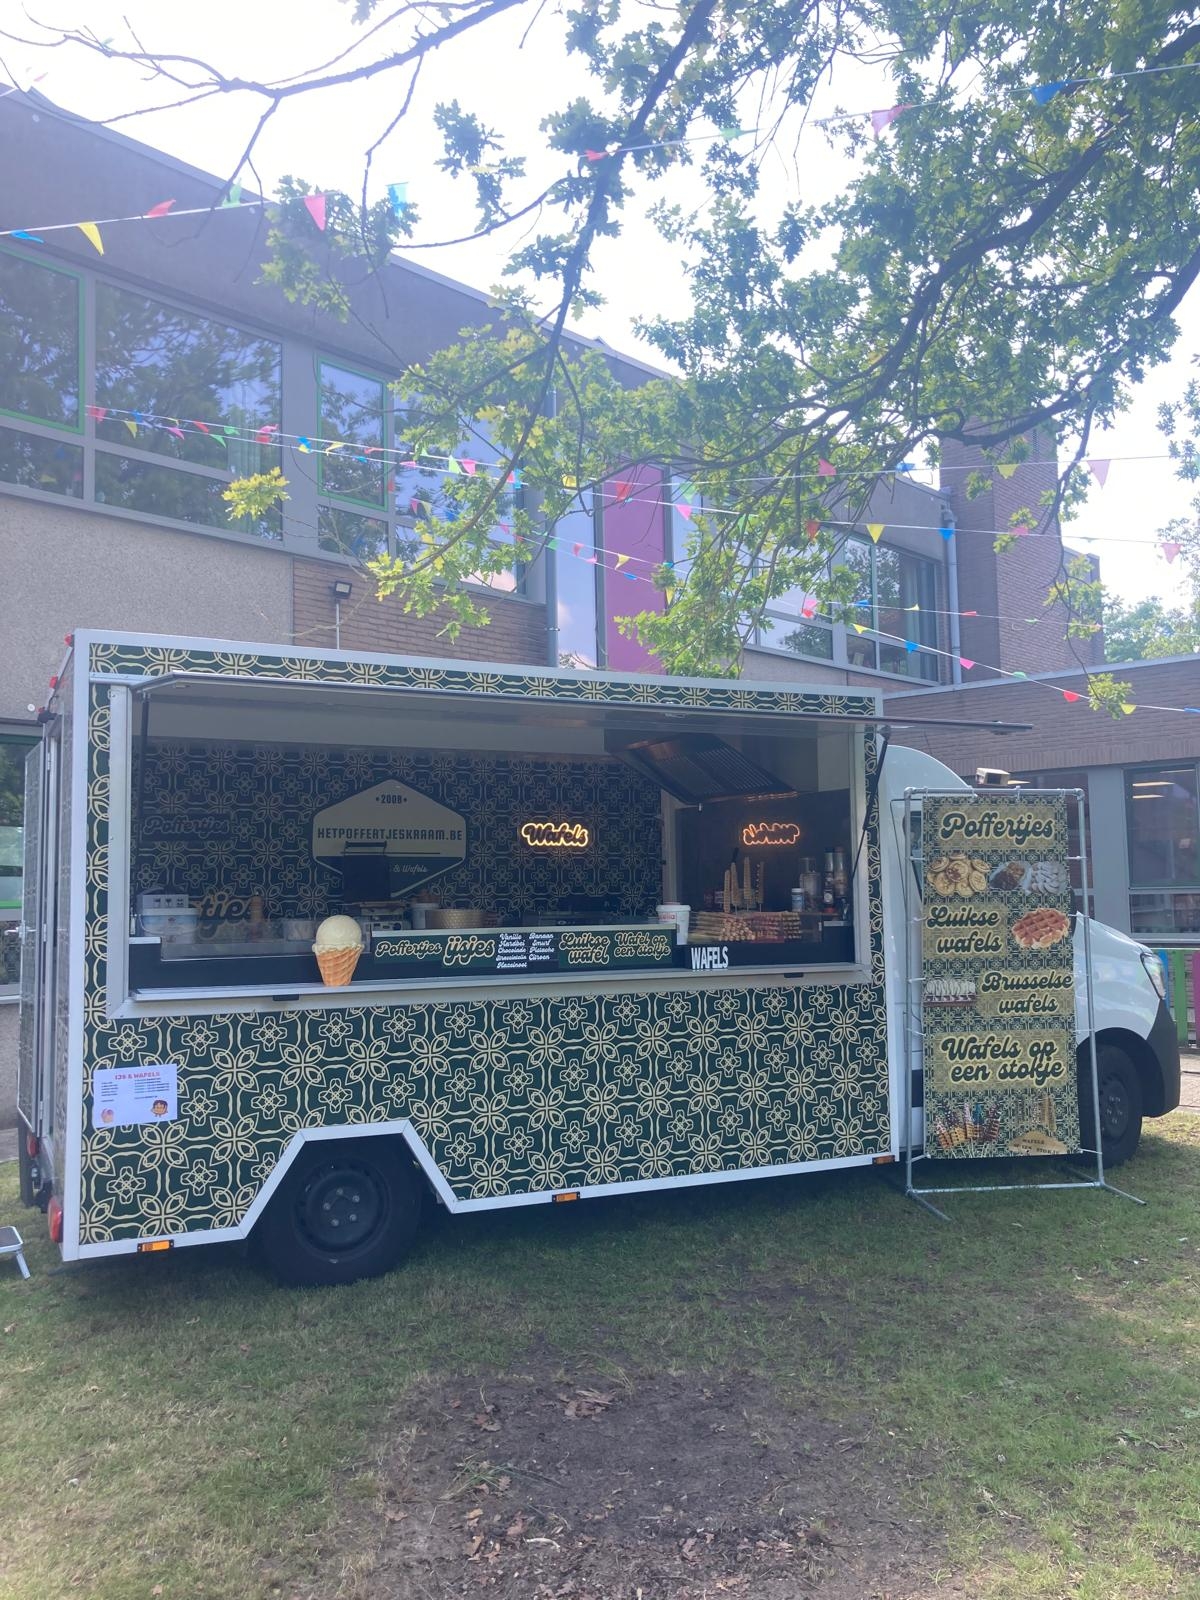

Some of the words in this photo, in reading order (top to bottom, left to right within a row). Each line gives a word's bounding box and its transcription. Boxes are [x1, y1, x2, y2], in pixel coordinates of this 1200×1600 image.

[381, 794, 402, 804] 2008
[143, 816, 230, 838] Poffertjes
[317, 828, 463, 841] HETPOFFERTJESKRAAM.BE
[521, 822, 589, 847] Wafels
[940, 811, 1054, 847] Poffertjes
[926, 905, 1001, 928] Luikse
[375, 940, 442, 960] Poffertjes
[443, 935, 496, 966] ijsjes
[559, 931, 611, 950] Luikse
[613, 945, 635, 957] een
[636, 943, 671, 960] stokje
[614, 932, 650, 946] Wafel
[650, 934, 667, 949] op
[936, 929, 1003, 954] wafels
[568, 947, 610, 964] wafel
[691, 946, 729, 969] WAFELS
[981, 970, 1074, 992] Brusselse
[998, 993, 1059, 1014] wafels
[940, 1034, 1022, 1062] Wafels
[1028, 1040, 1058, 1062] op
[950, 1064, 992, 1083] een
[997, 1057, 1065, 1086] stokje
